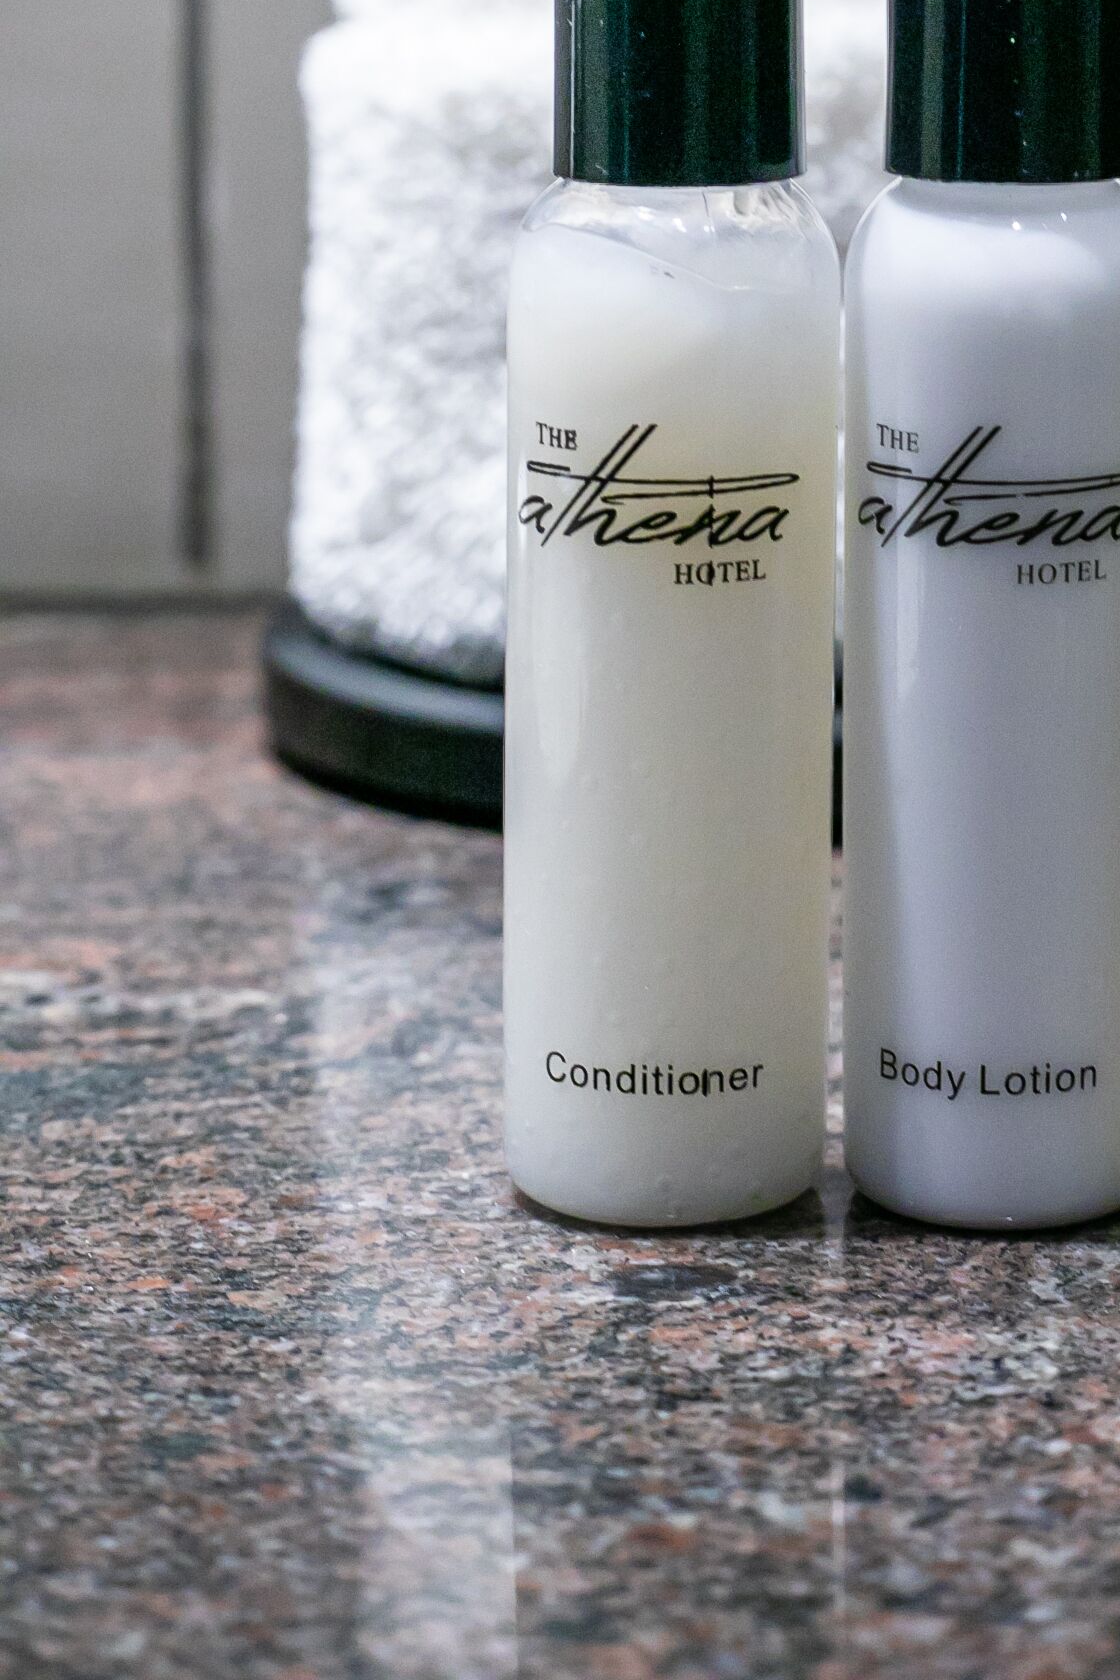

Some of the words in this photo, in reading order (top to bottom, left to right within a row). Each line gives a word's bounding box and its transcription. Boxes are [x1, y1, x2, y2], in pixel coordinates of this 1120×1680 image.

[535, 421, 578, 451] THE
[876, 423, 919, 453] THE
[518, 423, 800, 548] athena
[673, 559, 767, 587] HOTEL
[1016, 559, 1107, 586] HOTEL
[545, 1050, 764, 1098] Conditioner
[879, 1047, 966, 1101] Body
[979, 1064, 1098, 1097] Lotion
